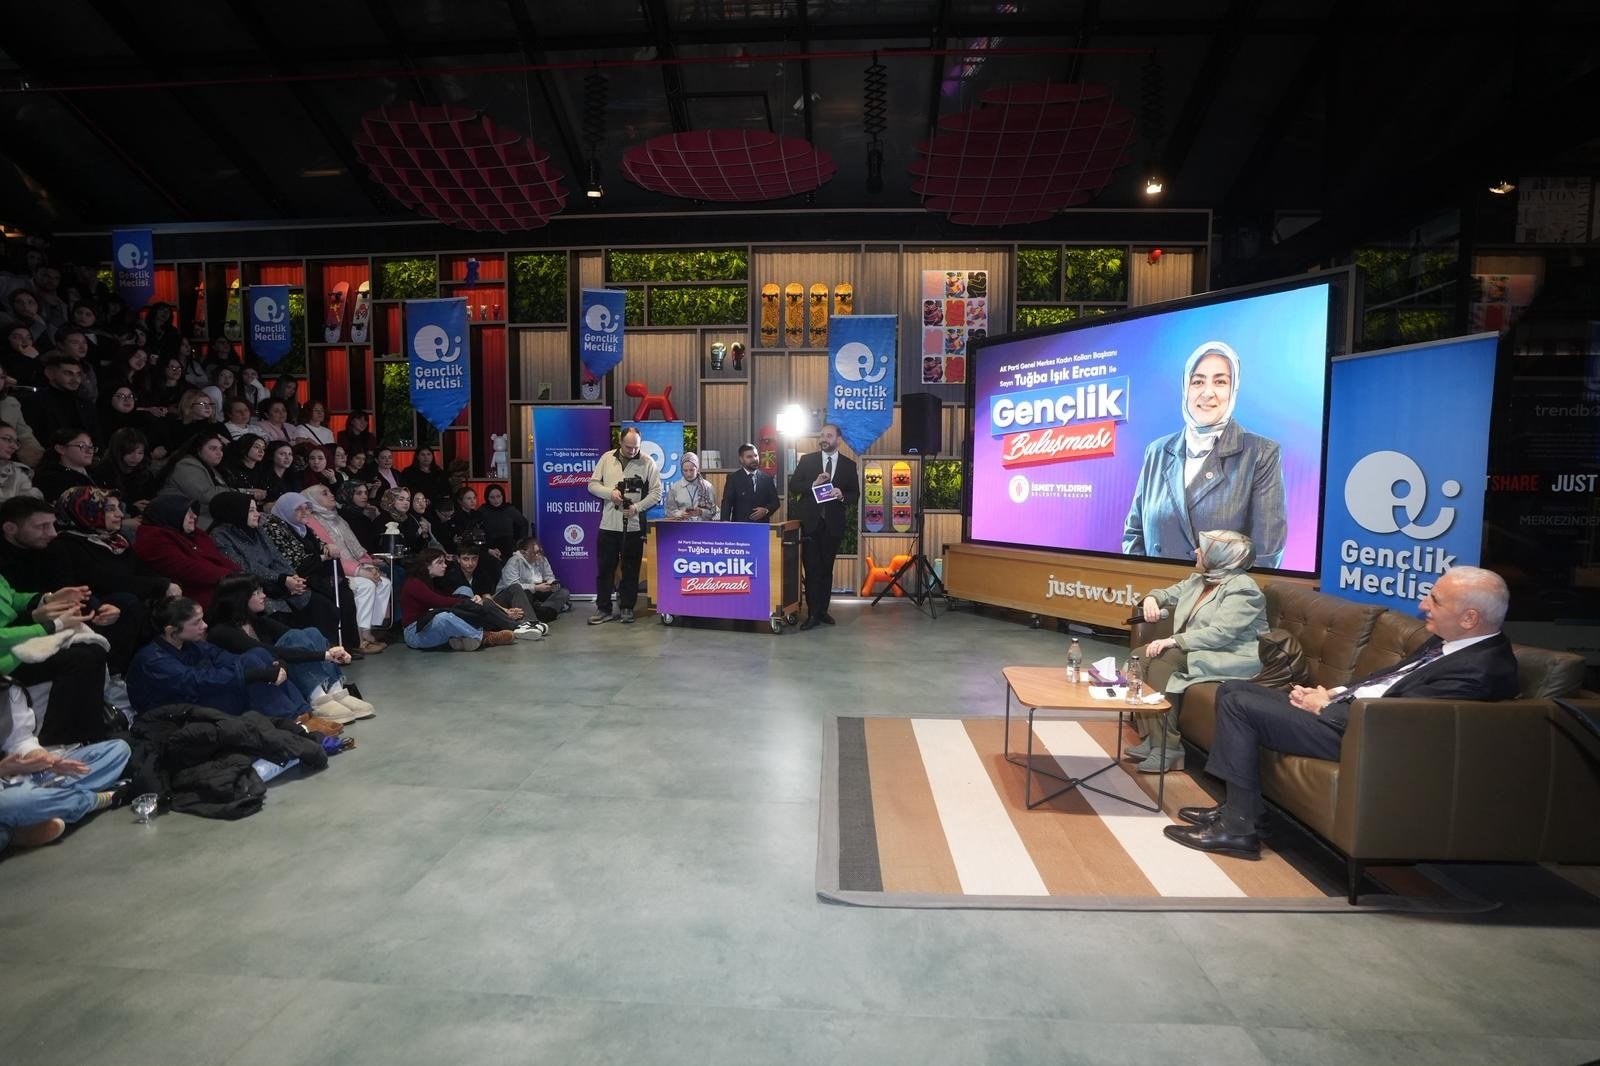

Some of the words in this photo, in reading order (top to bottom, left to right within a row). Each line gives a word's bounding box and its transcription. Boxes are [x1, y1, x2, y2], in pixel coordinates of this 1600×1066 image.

[584, 333, 619, 345] Gençlik
[414, 364, 463, 379] Gençlik
[1014, 372, 1048, 388] Tuğba
[1050, 368, 1070, 385] Işık
[1072, 364, 1107, 379] Ercan
[834, 384, 887, 399] Gençlik
[992, 383, 1123, 427] Gençlik
[1003, 428, 1112, 461] Buluşması
[549, 474, 592, 486] Buluşma
[1490, 474, 1540, 492] SHARE
[1551, 474, 1599, 493] JUST
[546, 501, 563, 514] HOŞ
[564, 500, 601, 513] GELDİNİZ
[687, 546, 709, 555] Tuğba
[710, 546, 723, 556] Işık
[724, 547, 744, 555] Ercan
[1341, 539, 1457, 574] Gençlik
[673, 558, 754, 576] Gençlik
[681, 577, 750, 592] Buluşması
[1046, 574, 1142, 607] justwork
[1340, 565, 1434, 601] Meclis
